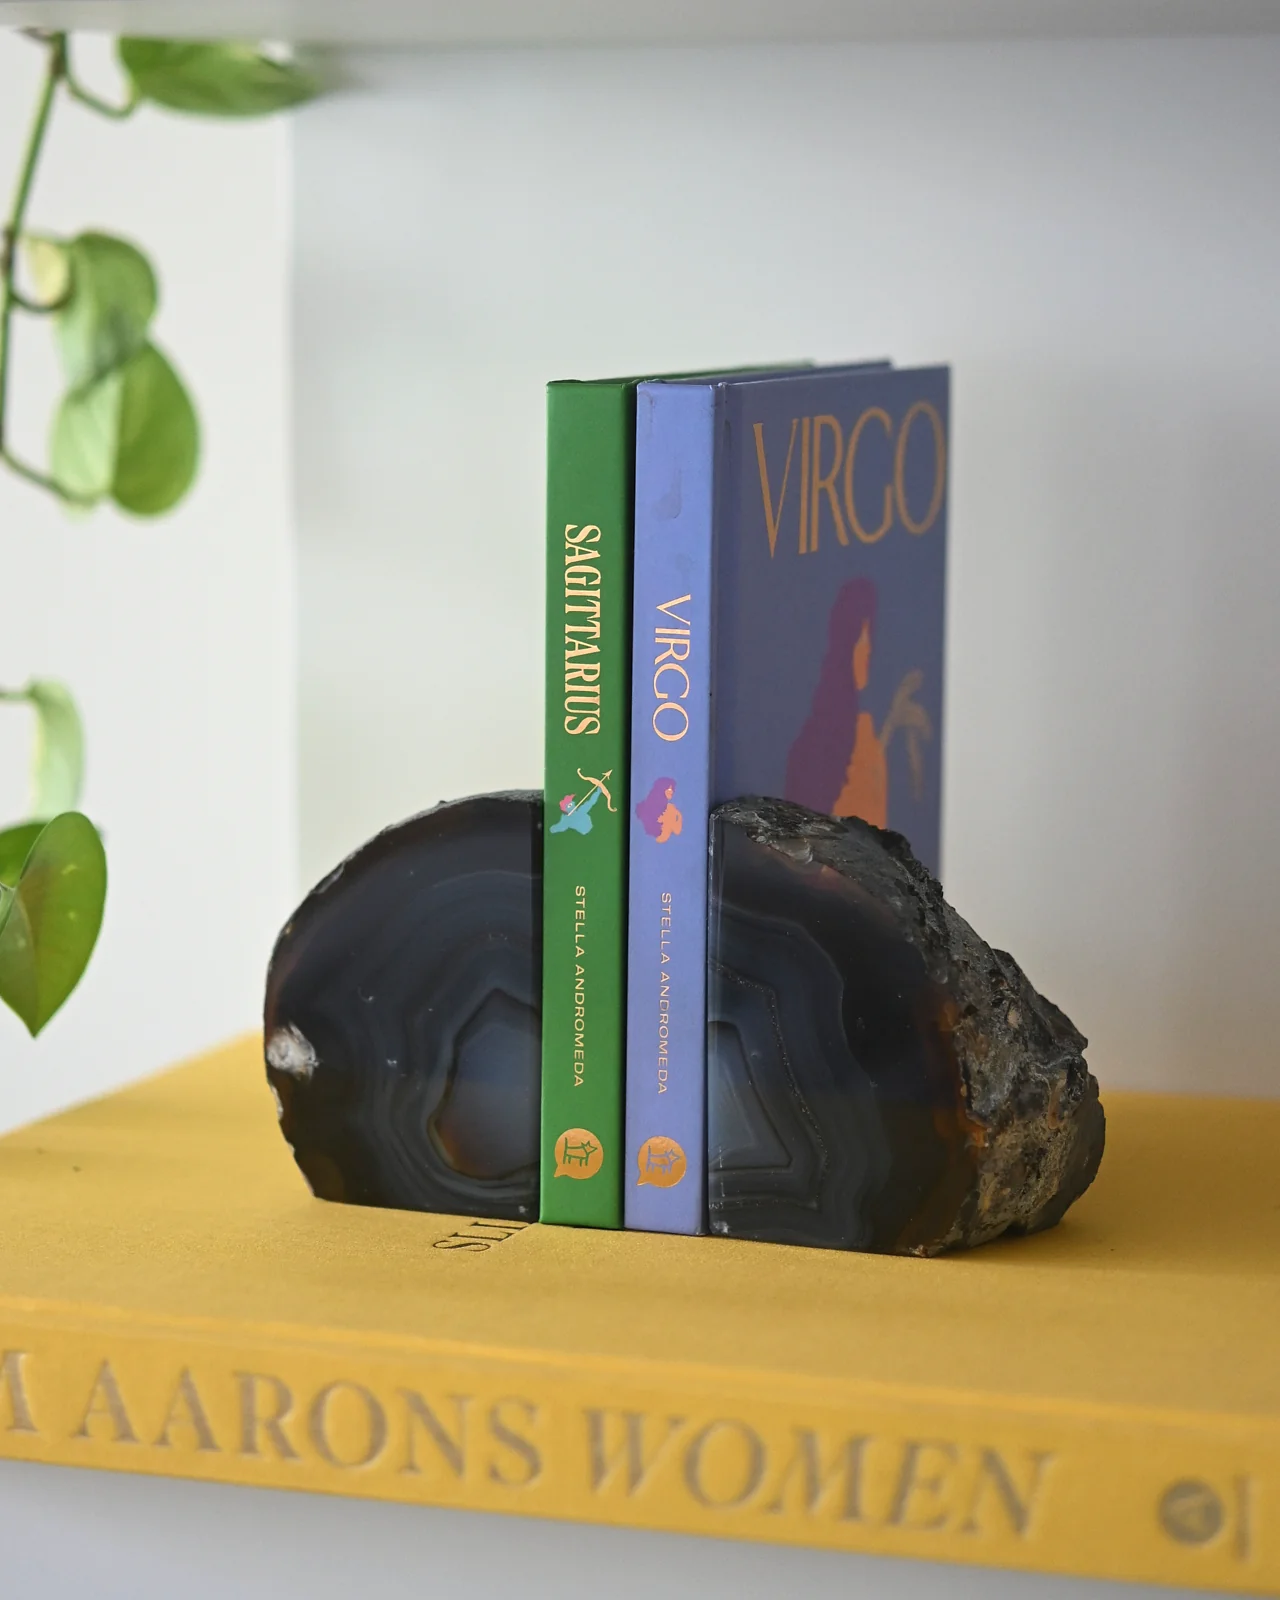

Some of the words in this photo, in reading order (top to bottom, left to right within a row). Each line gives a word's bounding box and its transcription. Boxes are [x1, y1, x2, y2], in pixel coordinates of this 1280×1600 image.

[752, 401, 946, 559] VIRGO
[563, 523, 602, 736] SAGITTARIUS
[652, 593, 692, 742] VIRGO
[575, 885, 586, 958] STELLA
[661, 893, 671, 964] STELLA
[574, 964, 585, 1087] ANDROMEDA
[658, 972, 670, 1094] ANDROMEDA
[71, 1359, 546, 1488] AARONS
[583, 1408, 1056, 1541] WOMEN
